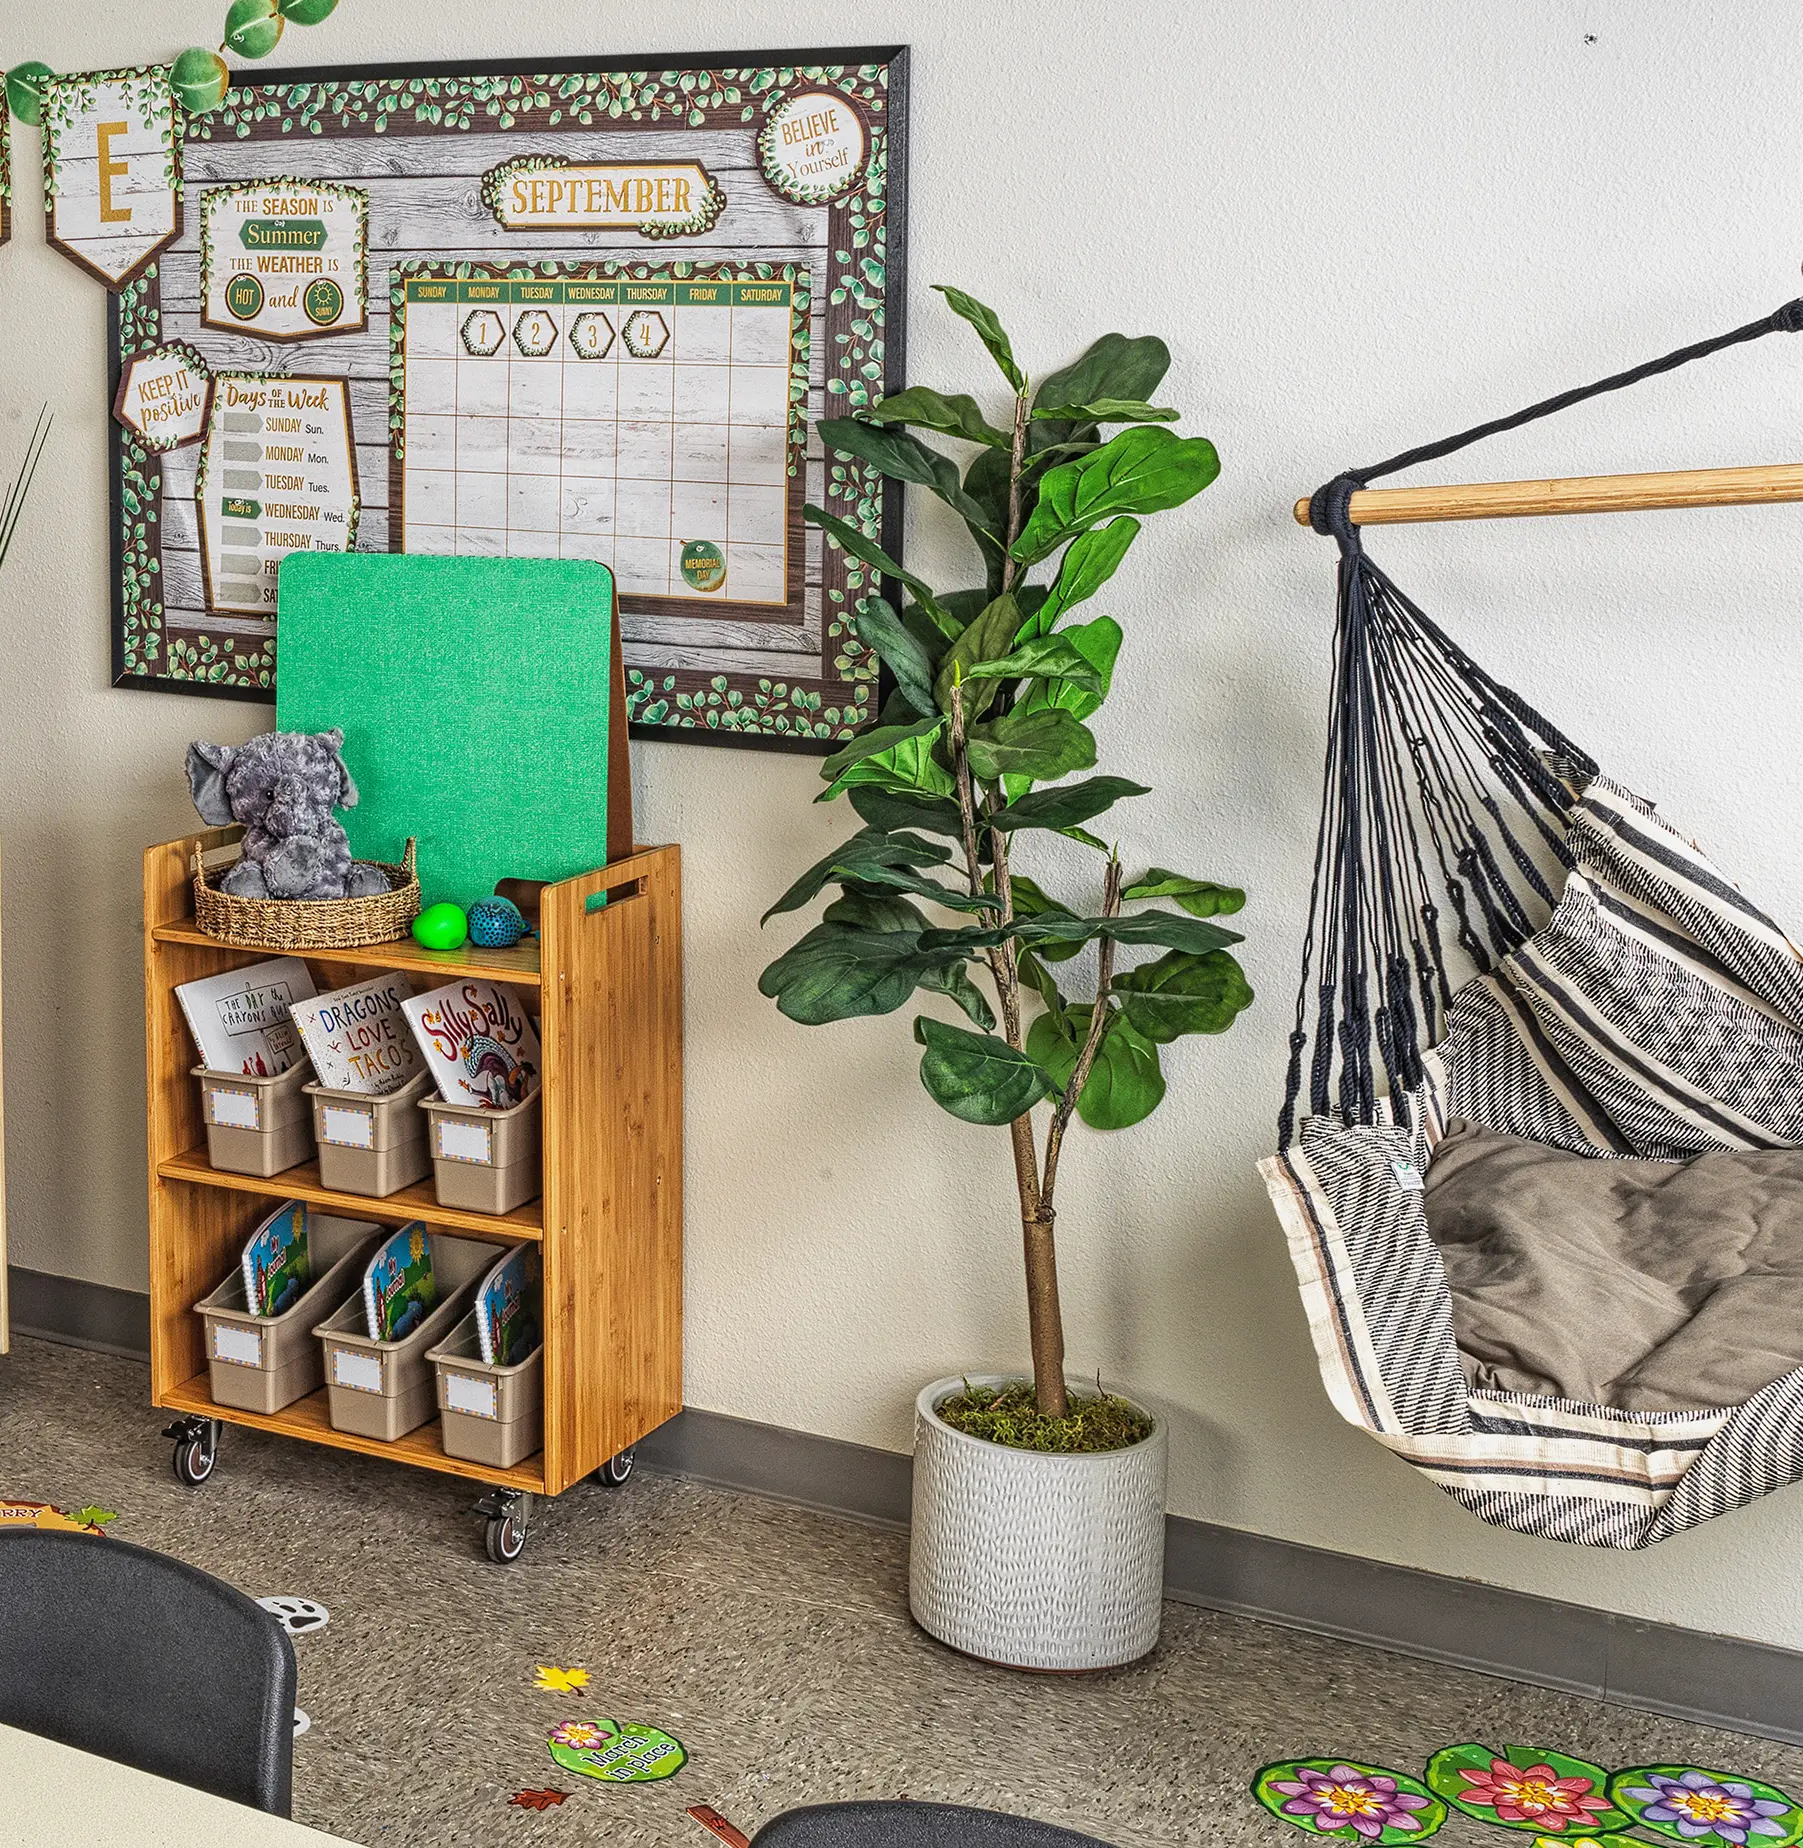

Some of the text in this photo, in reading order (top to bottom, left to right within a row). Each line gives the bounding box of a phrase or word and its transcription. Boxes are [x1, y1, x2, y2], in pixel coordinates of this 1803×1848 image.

[781, 108, 840, 146] BELIEVE
[804, 140, 825, 158] in
[786, 147, 849, 179] Yourself
[235, 198, 334, 215] THE SEASON IS
[512, 177, 692, 215] SEPTEMBER
[247, 223, 321, 246] Summer
[229, 255, 339, 274] THE WEATHER IS
[235, 285, 299, 308] HOT and
[418, 286, 447, 298] SUNDAY
[468, 286, 500, 299] MONDAY
[520, 286, 554, 299] TUESDAY
[567, 286, 616, 299] WEDNESDAY
[626, 286, 668, 300] THURSDAY
[689, 288, 717, 301] FRIDAY
[740, 288, 783, 302] SATURDAY
[315, 307, 334, 317] SUNNY
[479, 322, 487, 345] 1
[531, 322, 540, 345] 2
[588, 324, 597, 348] 3
[639, 322, 651, 346] 4
[138, 368, 190, 404] KEEP IT
[226, 384, 330, 412] Days OF THE Week
[140, 391, 201, 432] positive
[265, 416, 325, 435] SUNDAY Sun.
[265, 445, 329, 465] MONDAY Mon.
[264, 474, 330, 494] TUESDAY Tues.
[264, 502, 346, 524] WEDNESDAY Wed.
[264, 531, 312, 549] THURSDAY
[685, 558, 721, 569] MEMORIAL
[697, 570, 709, 580] DAY
[225, 988, 284, 1011] THE DAY the
[319, 987, 401, 1033] DRAGONS
[222, 1008, 266, 1026] CRAYONS
[421, 985, 522, 1061] Silly Sally
[345, 1018, 396, 1051] LOVE
[347, 1039, 414, 1080] TACOS
[583, 1733, 649, 1768] March
[604, 1742, 678, 1782] in place
